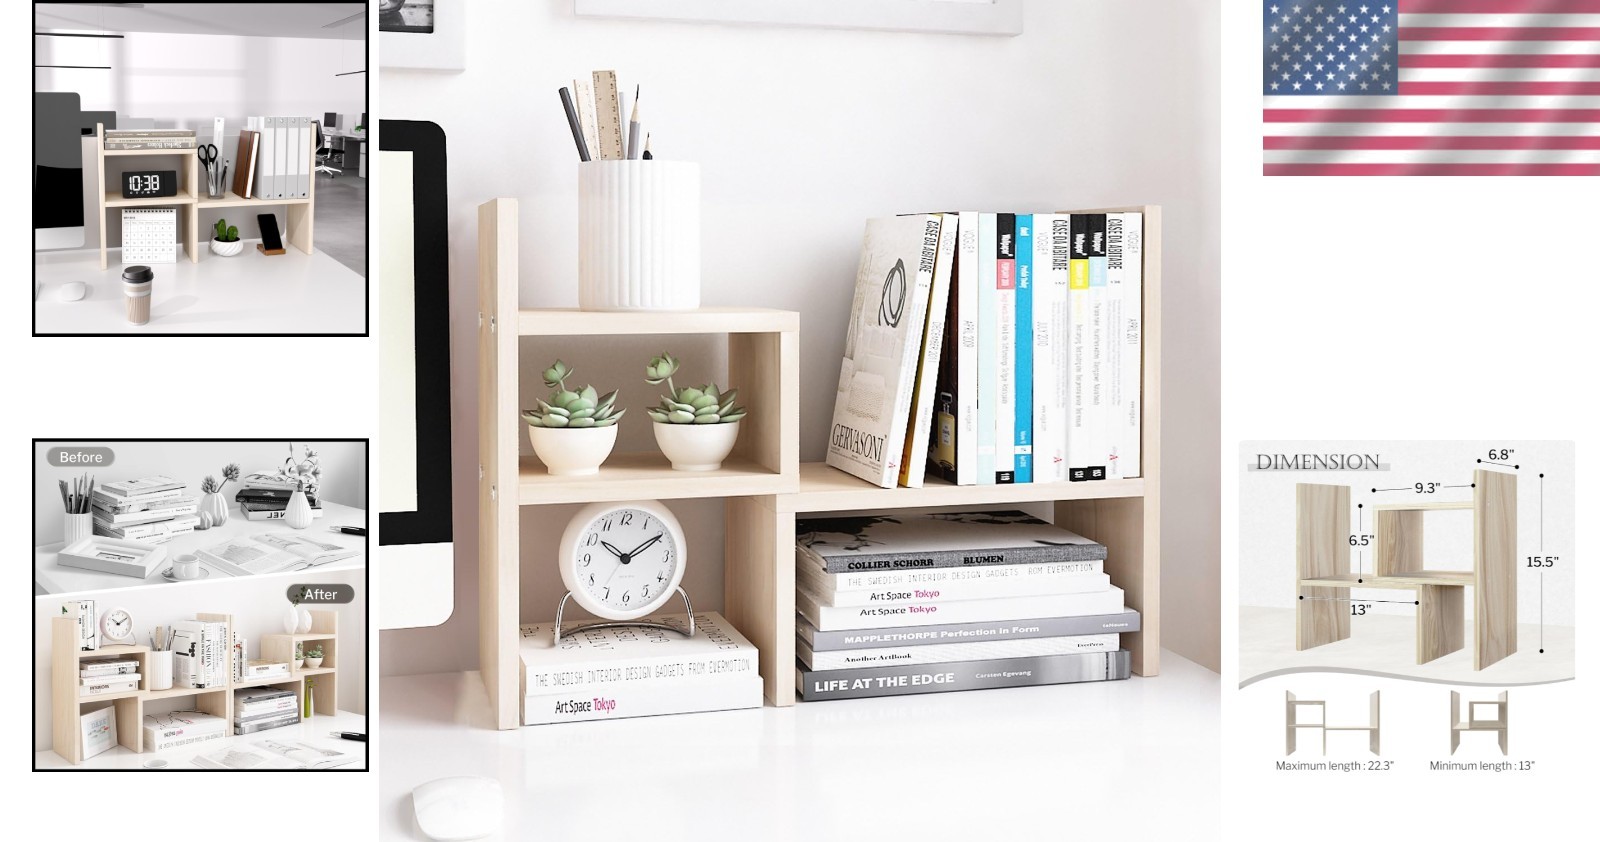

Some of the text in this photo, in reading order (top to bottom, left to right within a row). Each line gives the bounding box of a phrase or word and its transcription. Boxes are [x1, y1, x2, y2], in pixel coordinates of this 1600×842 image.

[128, 175, 160, 191] 10:38
[919, 221, 940, 273] CASE DA ABITARE
[1053, 220, 1067, 271] CASE DA ABITARE
[1108, 218, 1123, 270] CASE DA ABITARE
[832, 423, 884, 462] GERVASONI
[601, 519, 613, 532] 11
[619, 513, 633, 526] 12
[642, 518, 648, 530] 1
[586, 532, 599, 546] 10
[583, 553, 591, 567] 9
[662, 549, 670, 563] 3
[848, 555, 1004, 570] COLLIER SCHORR BLUMEN
[588, 572, 595, 586] 8
[656, 570, 664, 583] 4
[848, 563, 1093, 587] THE SWEDISH INTERIOR DESIGN GADGETS ROM EVERMOTION
[603, 586, 610, 600] 7
[622, 589, 630, 603] 6
[641, 584, 650, 597] 5
[870, 589, 940, 602] Art Space Tokyo
[860, 605, 937, 616] Art Space Tokyo
[844, 631, 938, 644] MAPPLETHORPE
[940, 628, 996, 638] Perfection
[1012, 626, 1040, 634] Form
[844, 653, 912, 663] Another ArtBook
[535, 658, 750, 687] THE SWEDISH INTERIOR DESIGN GADGETS FROM EVERMOTION
[1002, 670, 1032, 678] Egevang
[814, 672, 955, 693] LIFE AT THE EDGE
[555, 697, 616, 715] Art Space Tokyo
